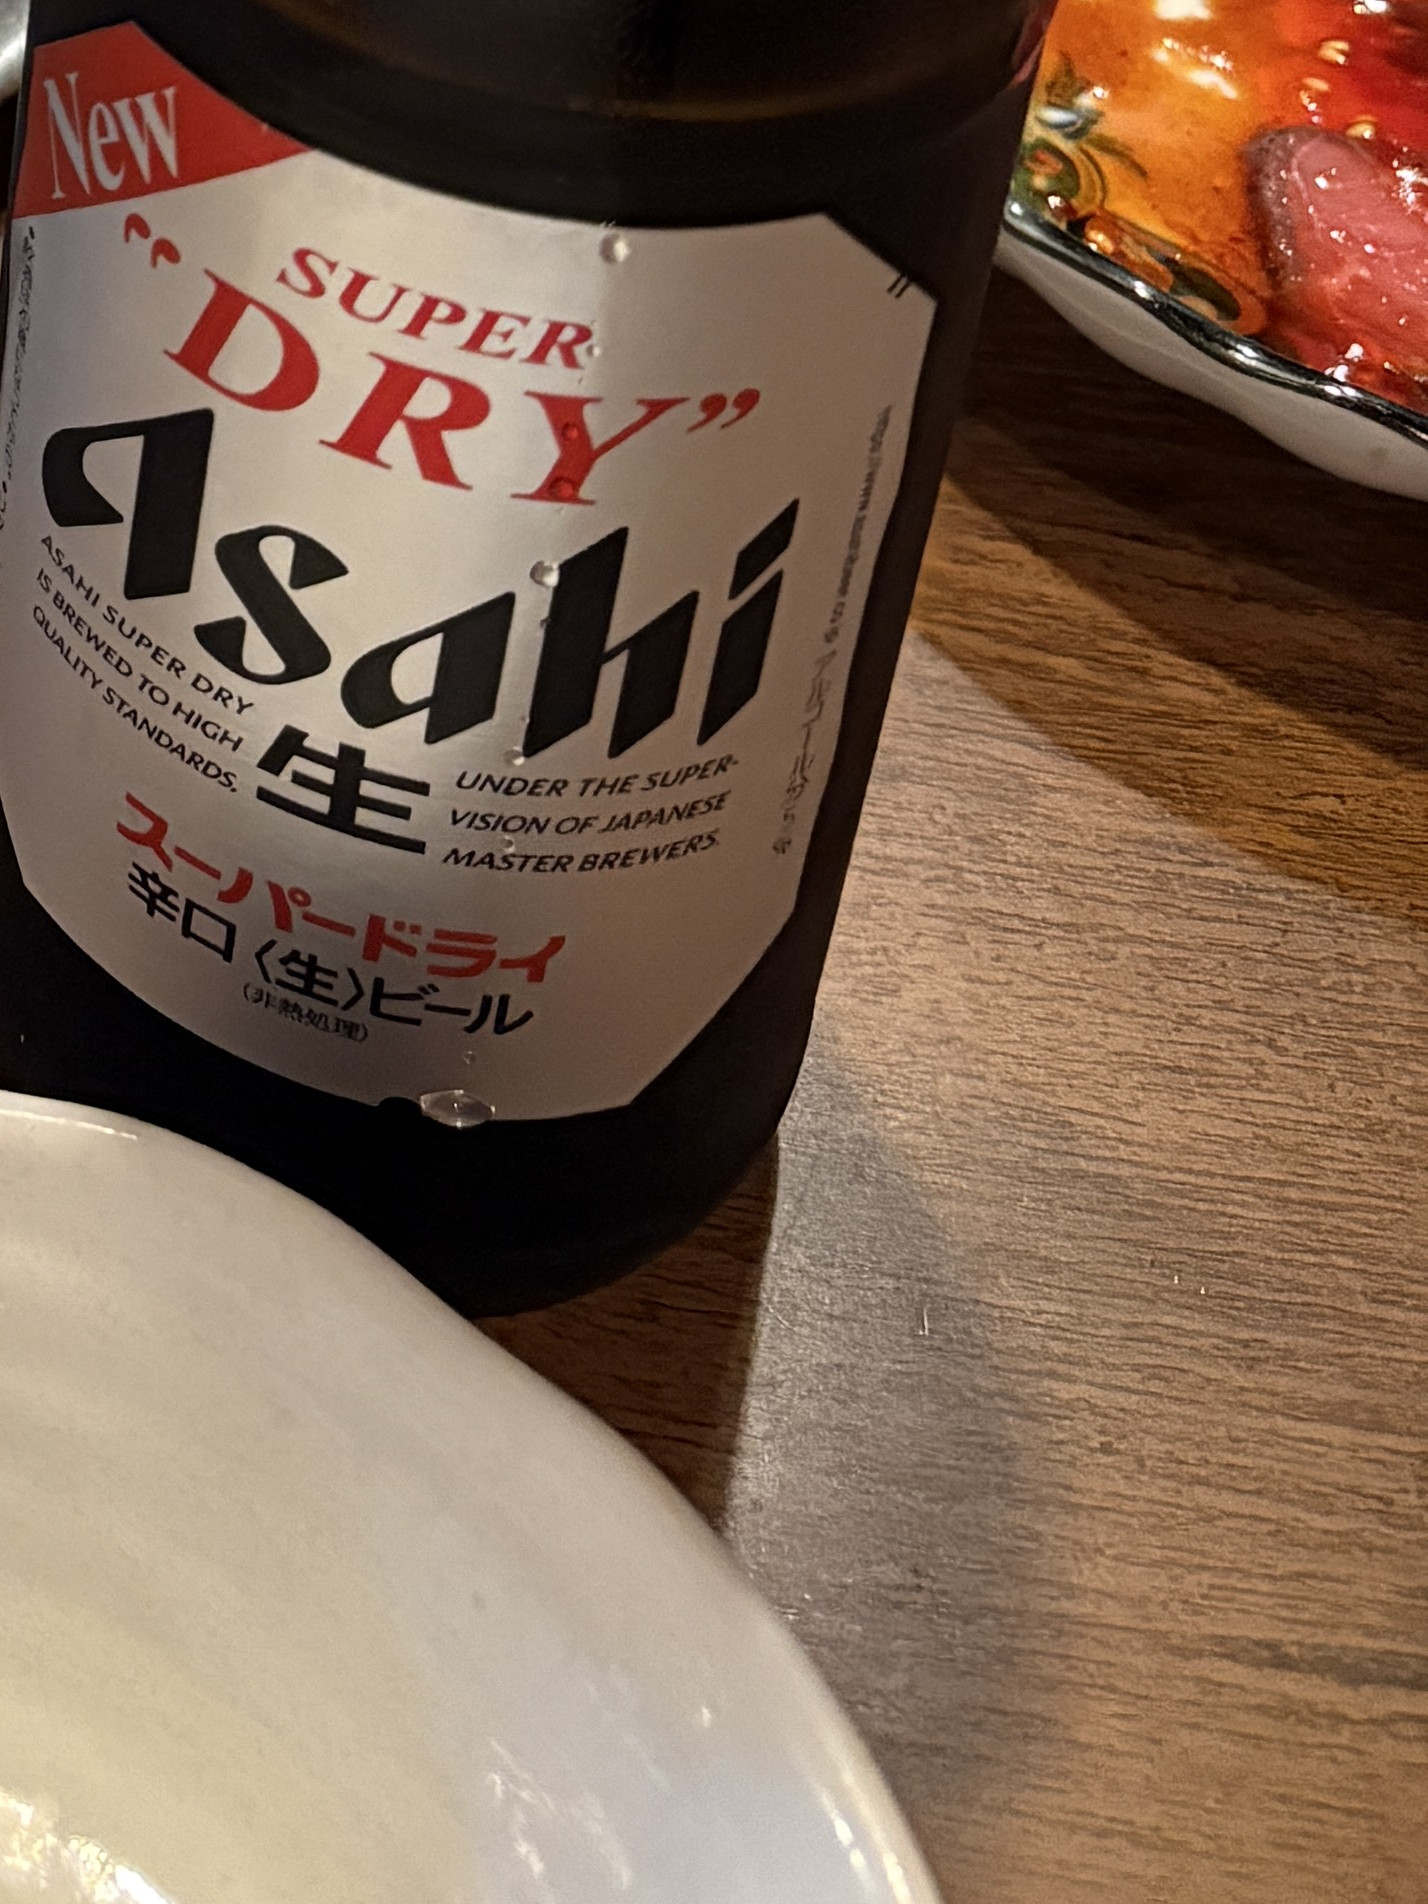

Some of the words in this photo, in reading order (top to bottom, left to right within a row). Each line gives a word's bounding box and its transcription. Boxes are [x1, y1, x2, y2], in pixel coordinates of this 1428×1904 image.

[43, 70, 178, 200] New
[275, 247, 596, 370] SUPER
[40, 534, 101, 609] ASAHI
[102, 604, 186, 680] SUPER
[191, 672, 255, 716] DRY
[41, 407, 801, 760] Asahi
[32, 604, 104, 690] QUALITY
[102, 686, 238, 794] STANDARDS.
[36, 567, 53, 594] IS
[52, 590, 134, 678] BREWED
[139, 673, 171, 707] TO
[172, 701, 245, 753] HIGH
[256, 723, 432, 856] 生
[449, 807, 551, 835] VISION
[554, 814, 600, 836] OF
[597, 789, 733, 835] JAPANESE
[455, 769, 571, 798] UNDER
[578, 773, 639, 798] THE
[640, 752, 740, 792] SUPER-
[115, 791, 567, 984] スーパードライ
[441, 846, 575, 874] MASTER
